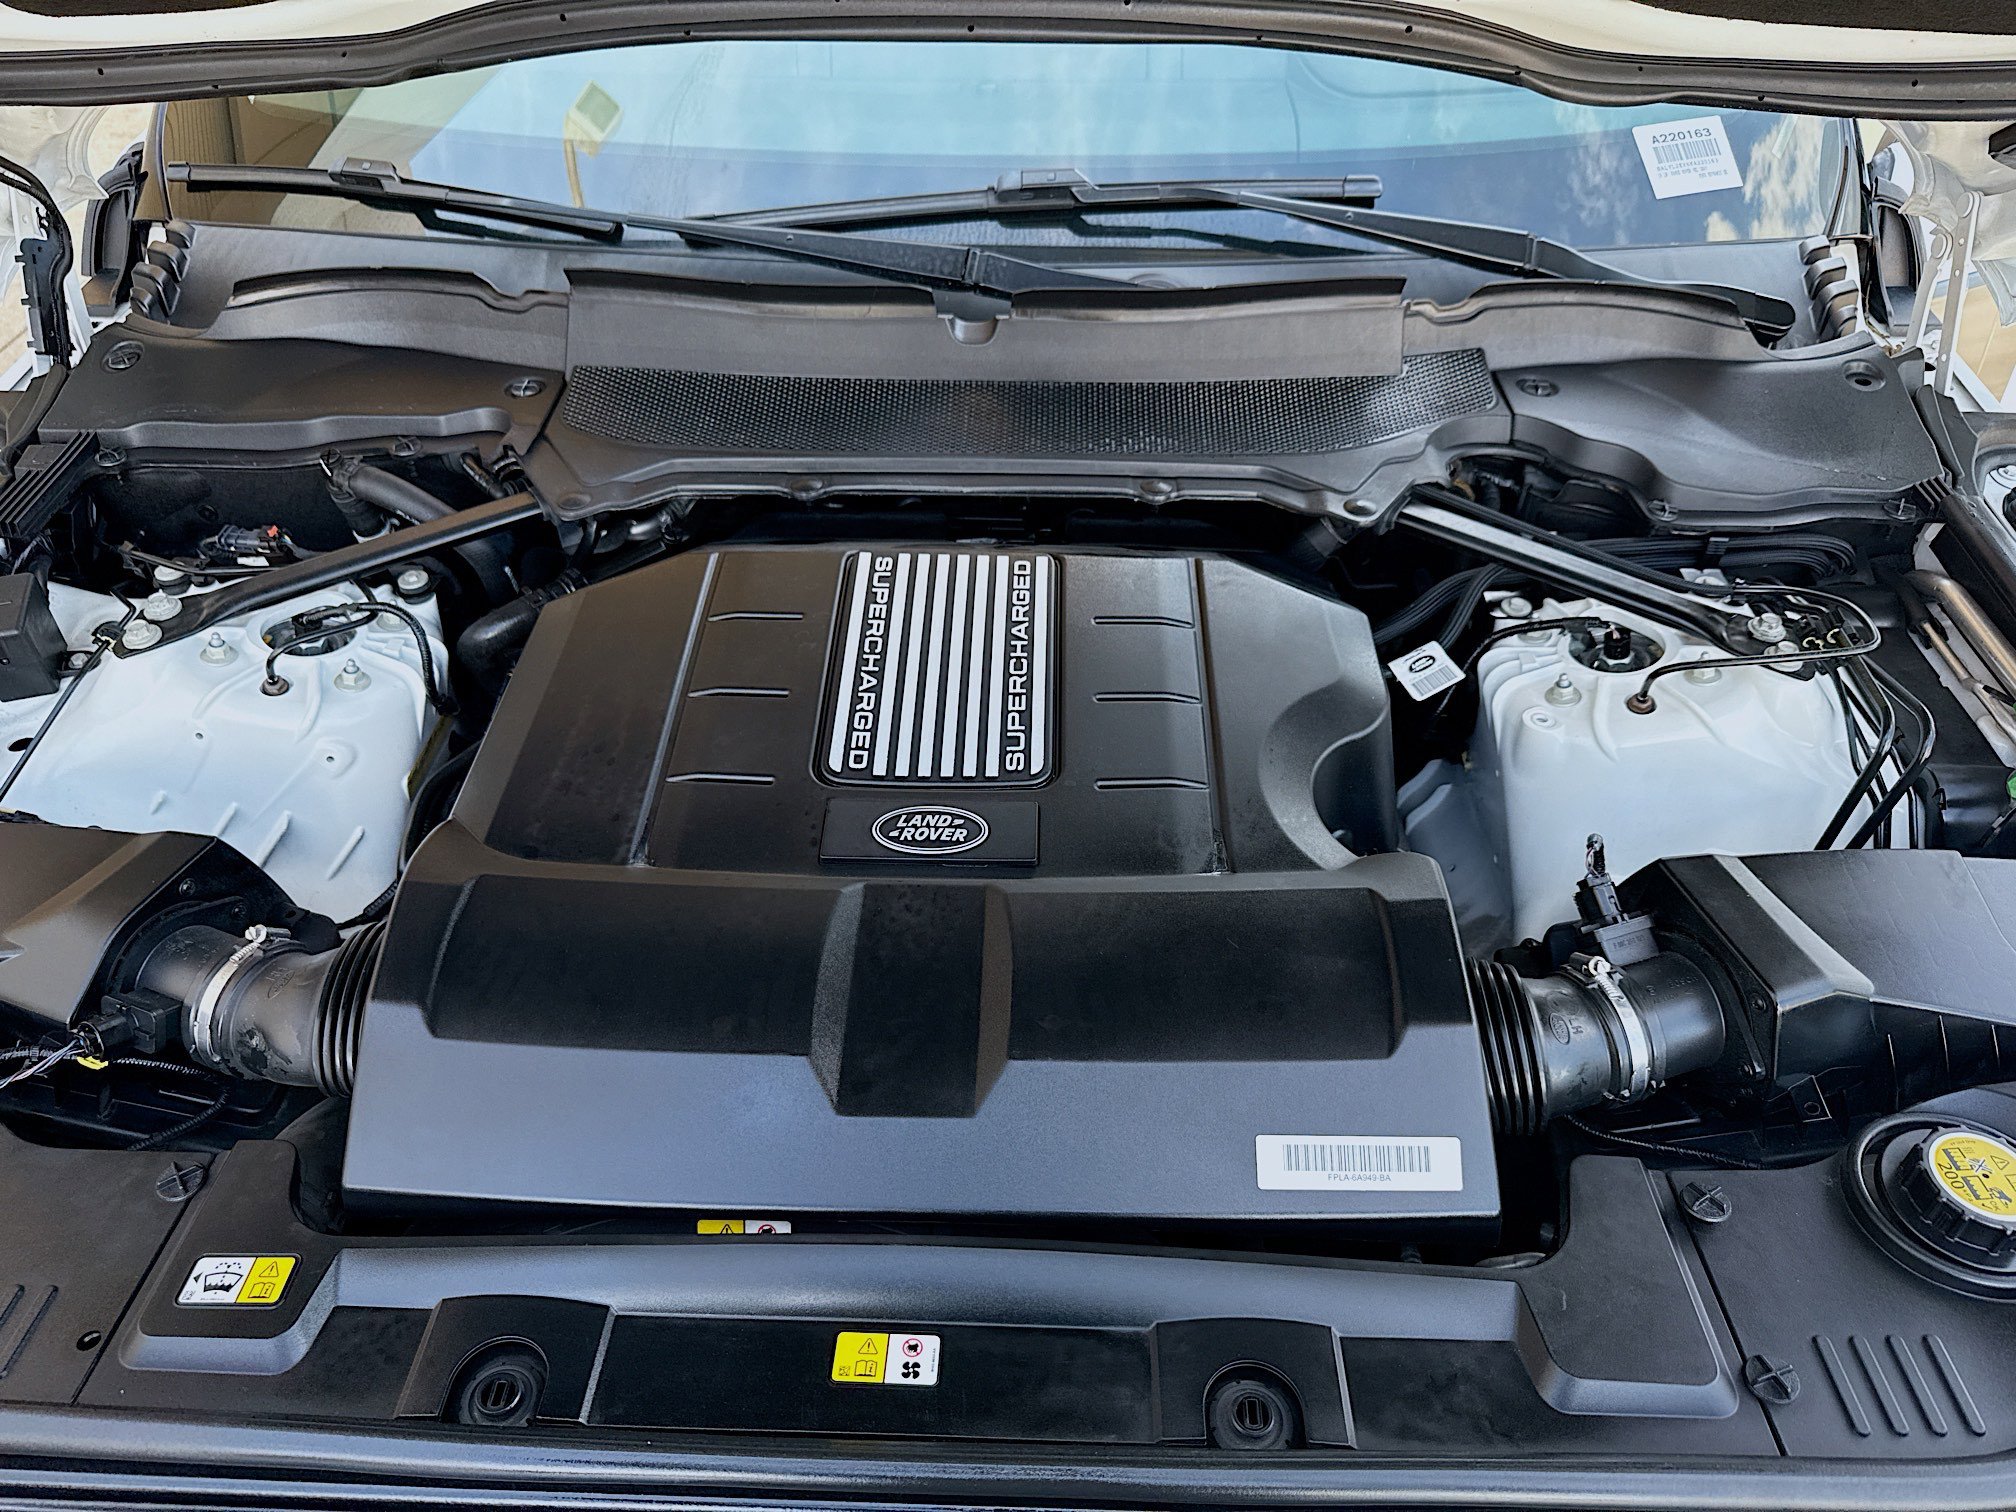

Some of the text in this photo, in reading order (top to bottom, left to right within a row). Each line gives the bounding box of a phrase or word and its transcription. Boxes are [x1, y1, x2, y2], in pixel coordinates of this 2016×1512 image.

[1652, 127, 1712, 144] A220163
[848, 556, 893, 770] SUPERCHARGED
[1005, 559, 1032, 771] SUPERCHARGED
[896, 814, 953, 827] LAND
[899, 827, 968, 842] ROVER
[1327, 1173, 1392, 1182] FPLA-6A949-BA
[1937, 1162, 1966, 1190] 200
